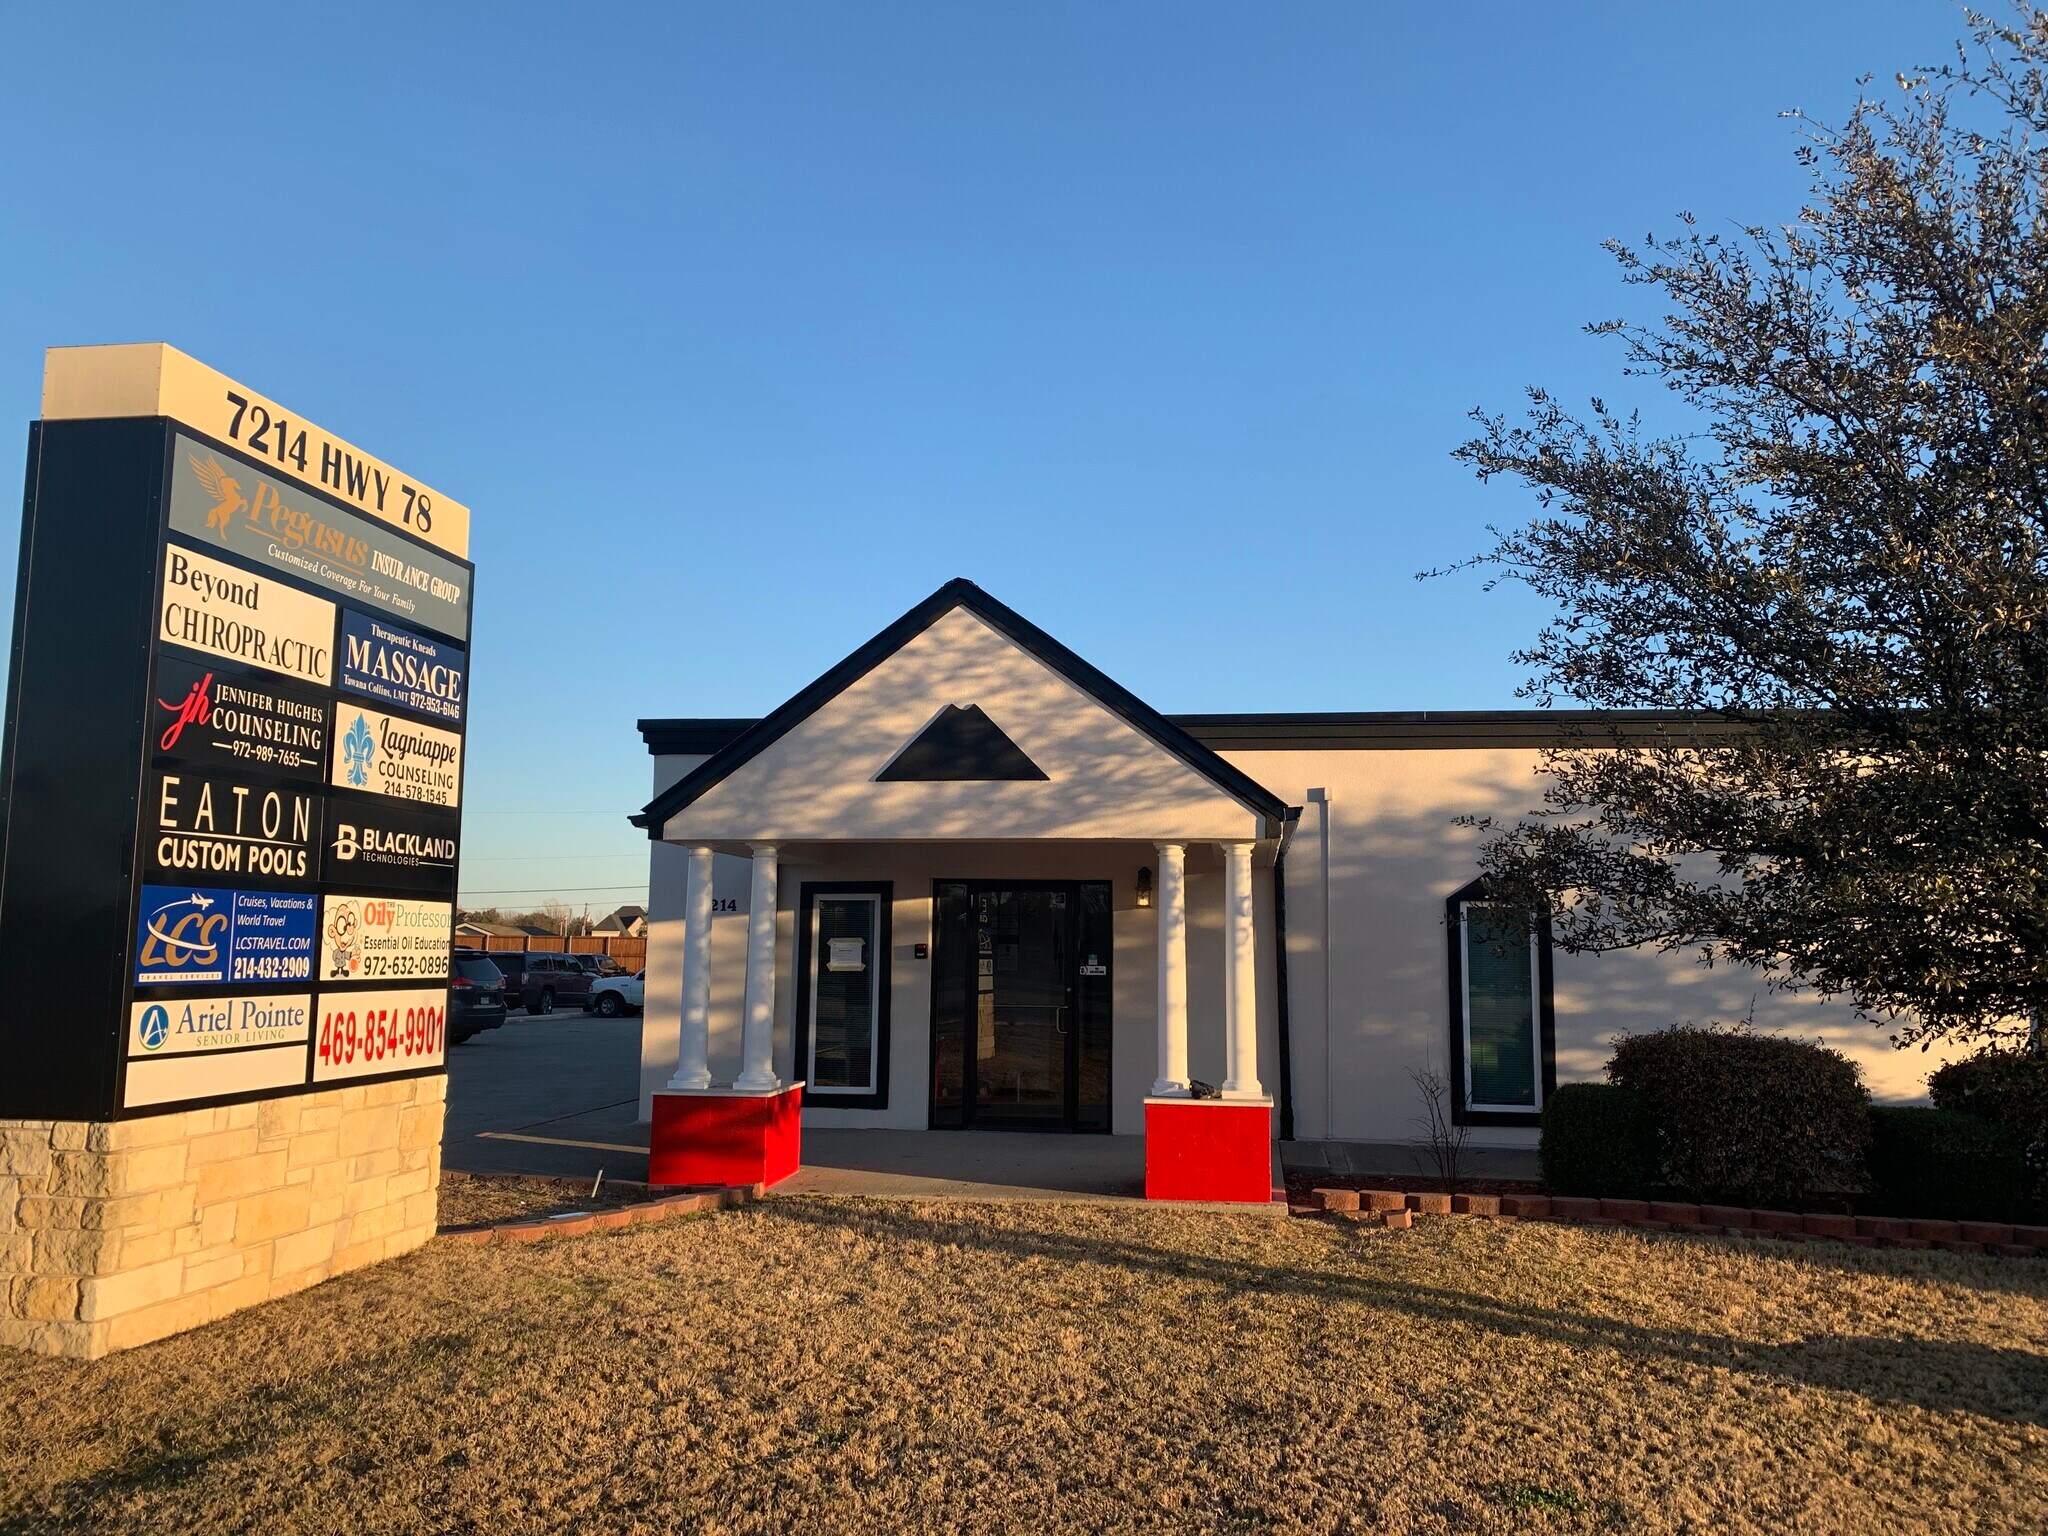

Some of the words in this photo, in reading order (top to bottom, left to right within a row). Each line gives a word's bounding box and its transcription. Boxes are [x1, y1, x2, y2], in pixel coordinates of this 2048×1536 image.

[227, 390, 308, 472] 7214
[320, 441, 390, 511] HWY
[401, 483, 432, 533] 78
[245, 479, 369, 567] Pegasus
[371, 550, 429, 592] INSURANCE
[430, 577, 461, 604] GROUP
[169, 552, 259, 611] Beyond
[268, 543, 319, 573] Customized
[320, 564, 357, 590] Coverage
[358, 579, 371, 594] For
[373, 585, 390, 601] Your
[392, 593, 416, 614] Family
[165, 602, 327, 678] CHIROPRACTIC
[371, 623, 411, 648] Therapeutic
[412, 638, 437, 657] Kneads
[345, 633, 461, 702] MASSAGE
[214, 683, 273, 712] JENNIFER
[276, 699, 323, 723] HUGHES
[343, 674, 367, 690] Tawana
[368, 681, 392, 699] Collins,
[393, 689, 410, 702] LMT
[410, 691, 460, 719] 972-953-6146
[212, 707, 322, 750] COUNSELING
[379, 717, 457, 768] Lagniappe
[232, 740, 300, 767] 972-989-7655
[378, 760, 454, 790] COUNSELING
[159, 775, 310, 842] EATON
[384, 780, 447, 805] 214-578-1545
[157, 836, 241, 872] CUSTOM
[248, 845, 307, 877] POOLS
[362, 851, 420, 867] TECHNOLOGIES
[363, 828, 455, 860] BLACKLAND
[238, 895, 268, 910] Cruises,
[270, 896, 306, 910] Vacations
[306, 898, 313, 910] &
[364, 901, 395, 934] Oily
[395, 904, 452, 928] Professor
[237, 914, 261, 926] World
[262, 914, 286, 927] Travel
[140, 912, 228, 967] LCS
[235, 936, 311, 950] LCSTRAVEL.COM
[364, 936, 400, 950] Essential
[402, 936, 413, 950] Oil
[414, 936, 450, 950] Education
[234, 956, 310, 980] 214-432-2909
[363, 956, 448, 976] 972-632-0896
[175, 1000, 233, 1034] Ariel
[240, 1000, 304, 1030] Pointe
[196, 1033, 240, 1047] SENIOR
[245, 1028, 285, 1043] LIVING
[318, 1005, 444, 1067] 469-854-9901
